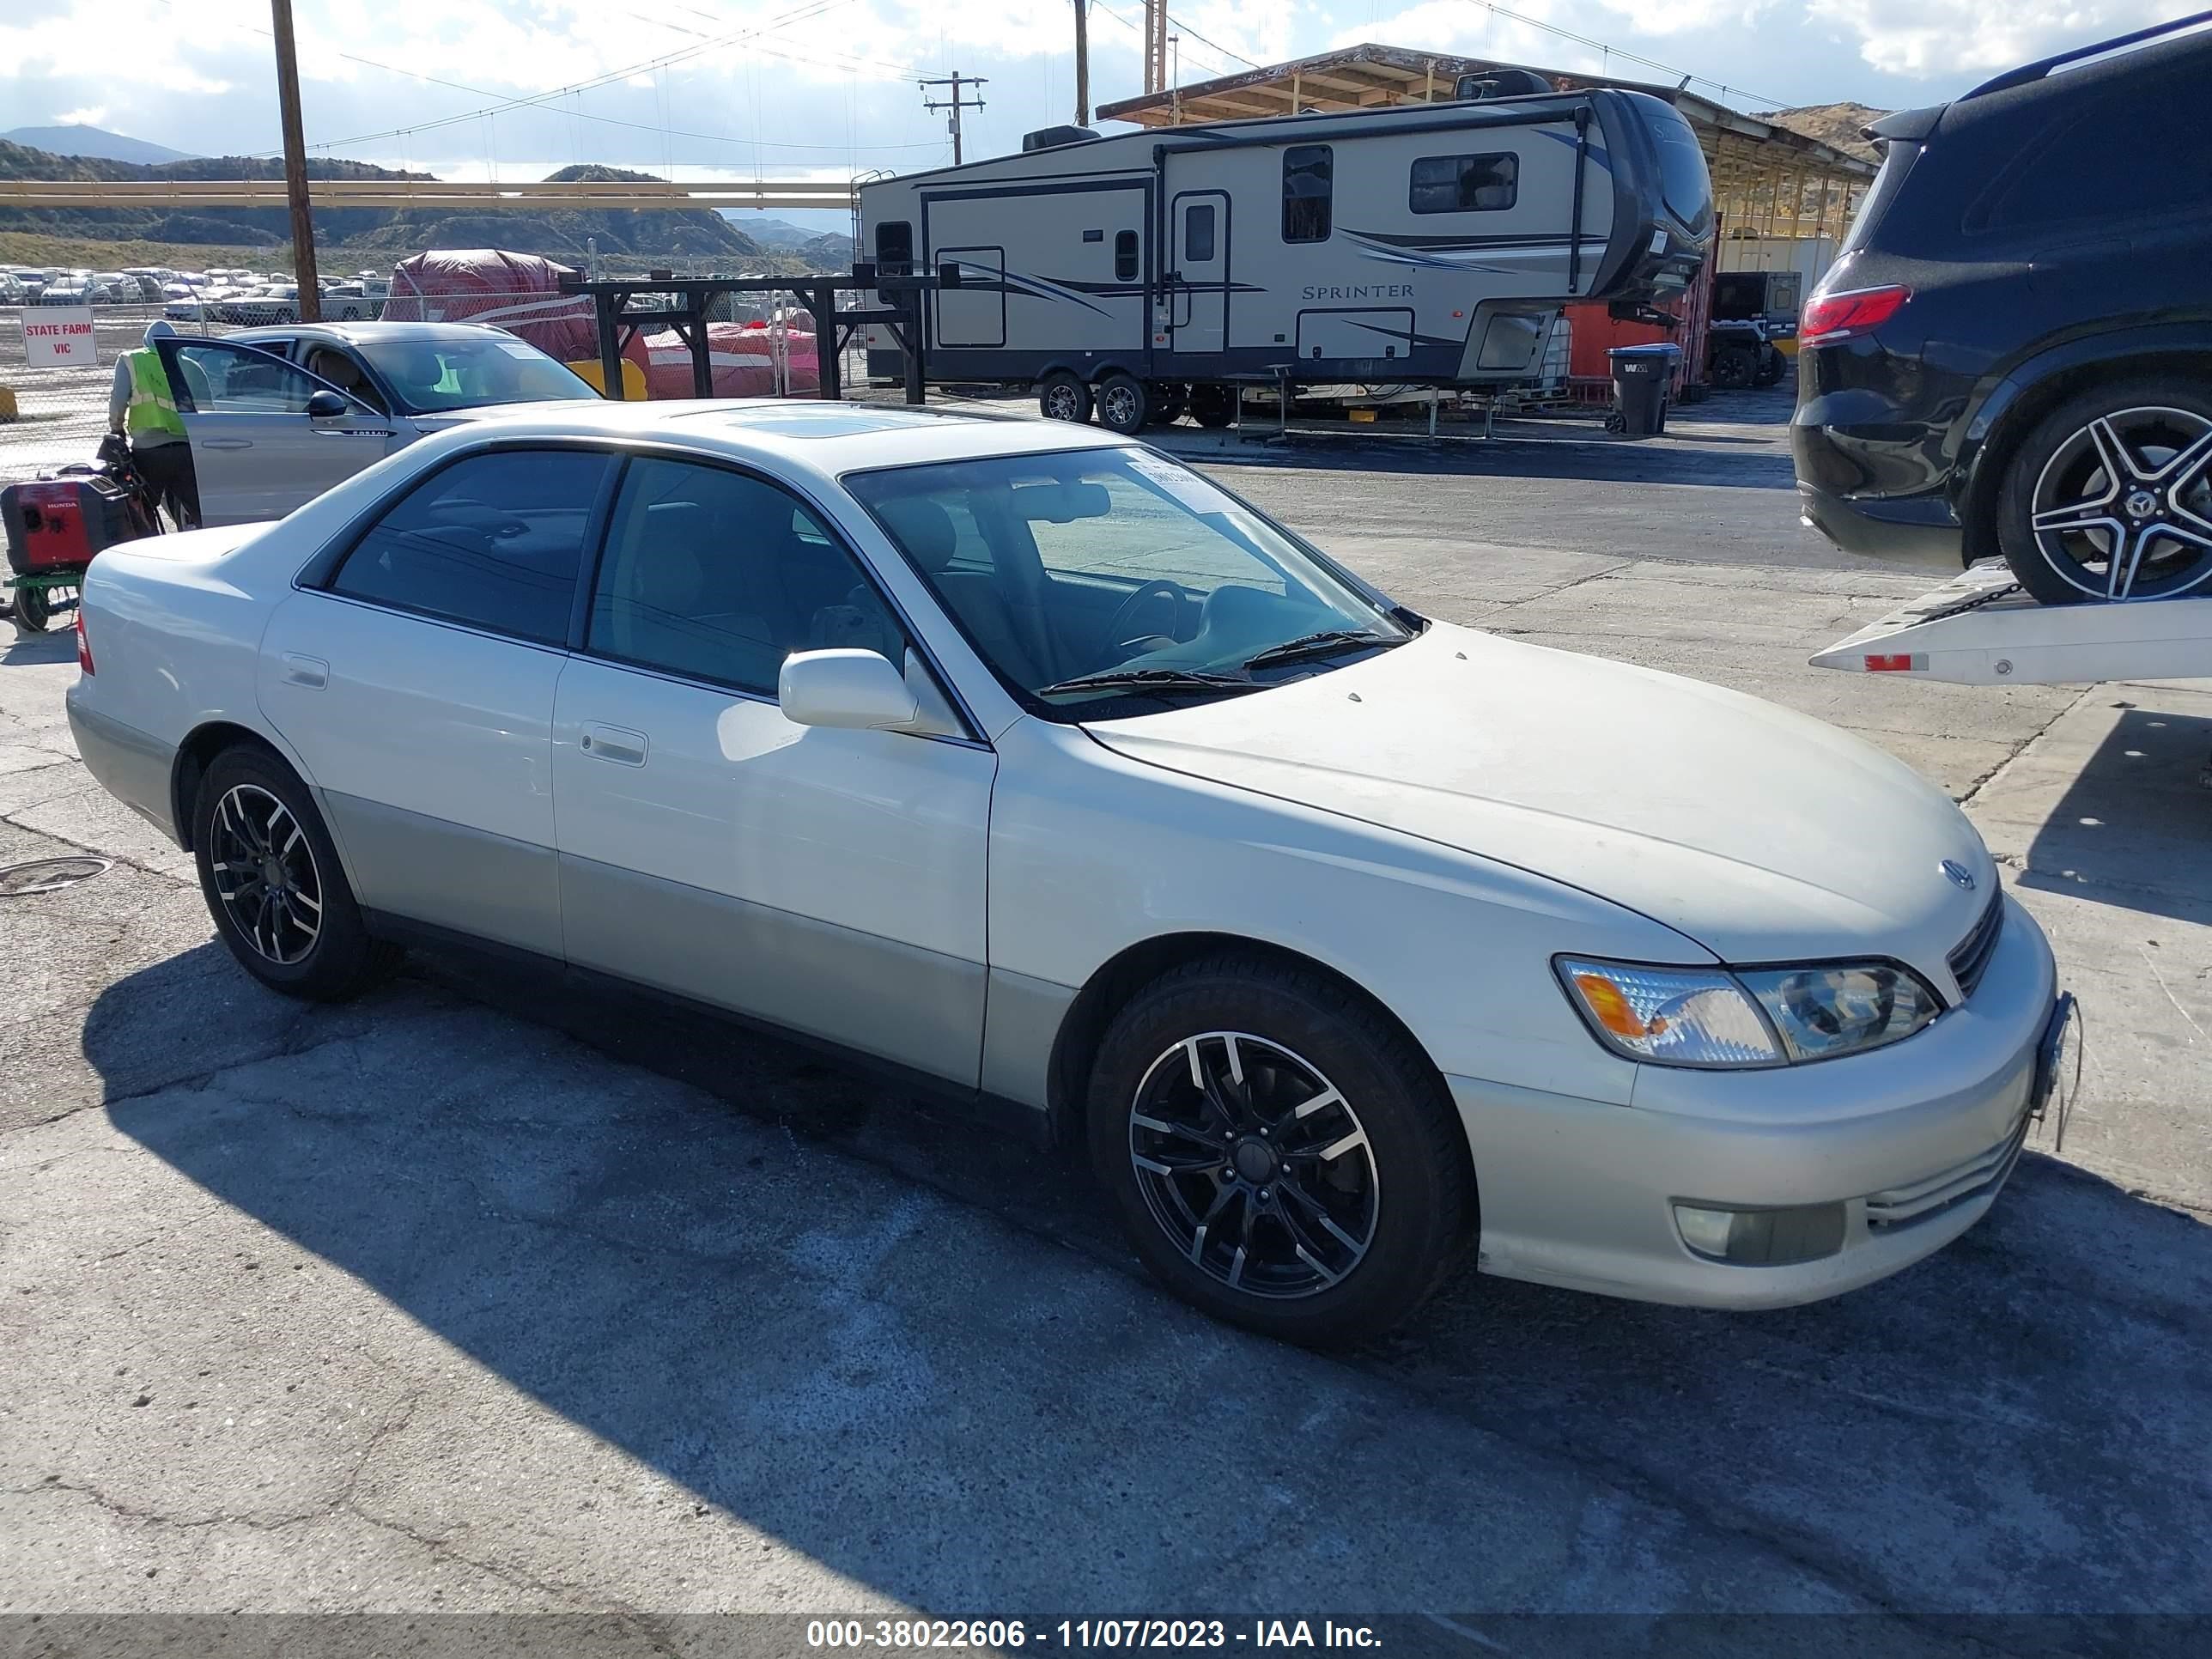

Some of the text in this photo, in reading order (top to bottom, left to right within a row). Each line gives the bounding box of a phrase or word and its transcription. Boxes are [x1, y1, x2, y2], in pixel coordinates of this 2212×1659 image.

[1302, 284, 1415, 300] SPRINTER
[26, 323, 92, 337] STATE FARM
[53, 343, 71, 355] VIC
[1624, 363, 1648, 373] WM
